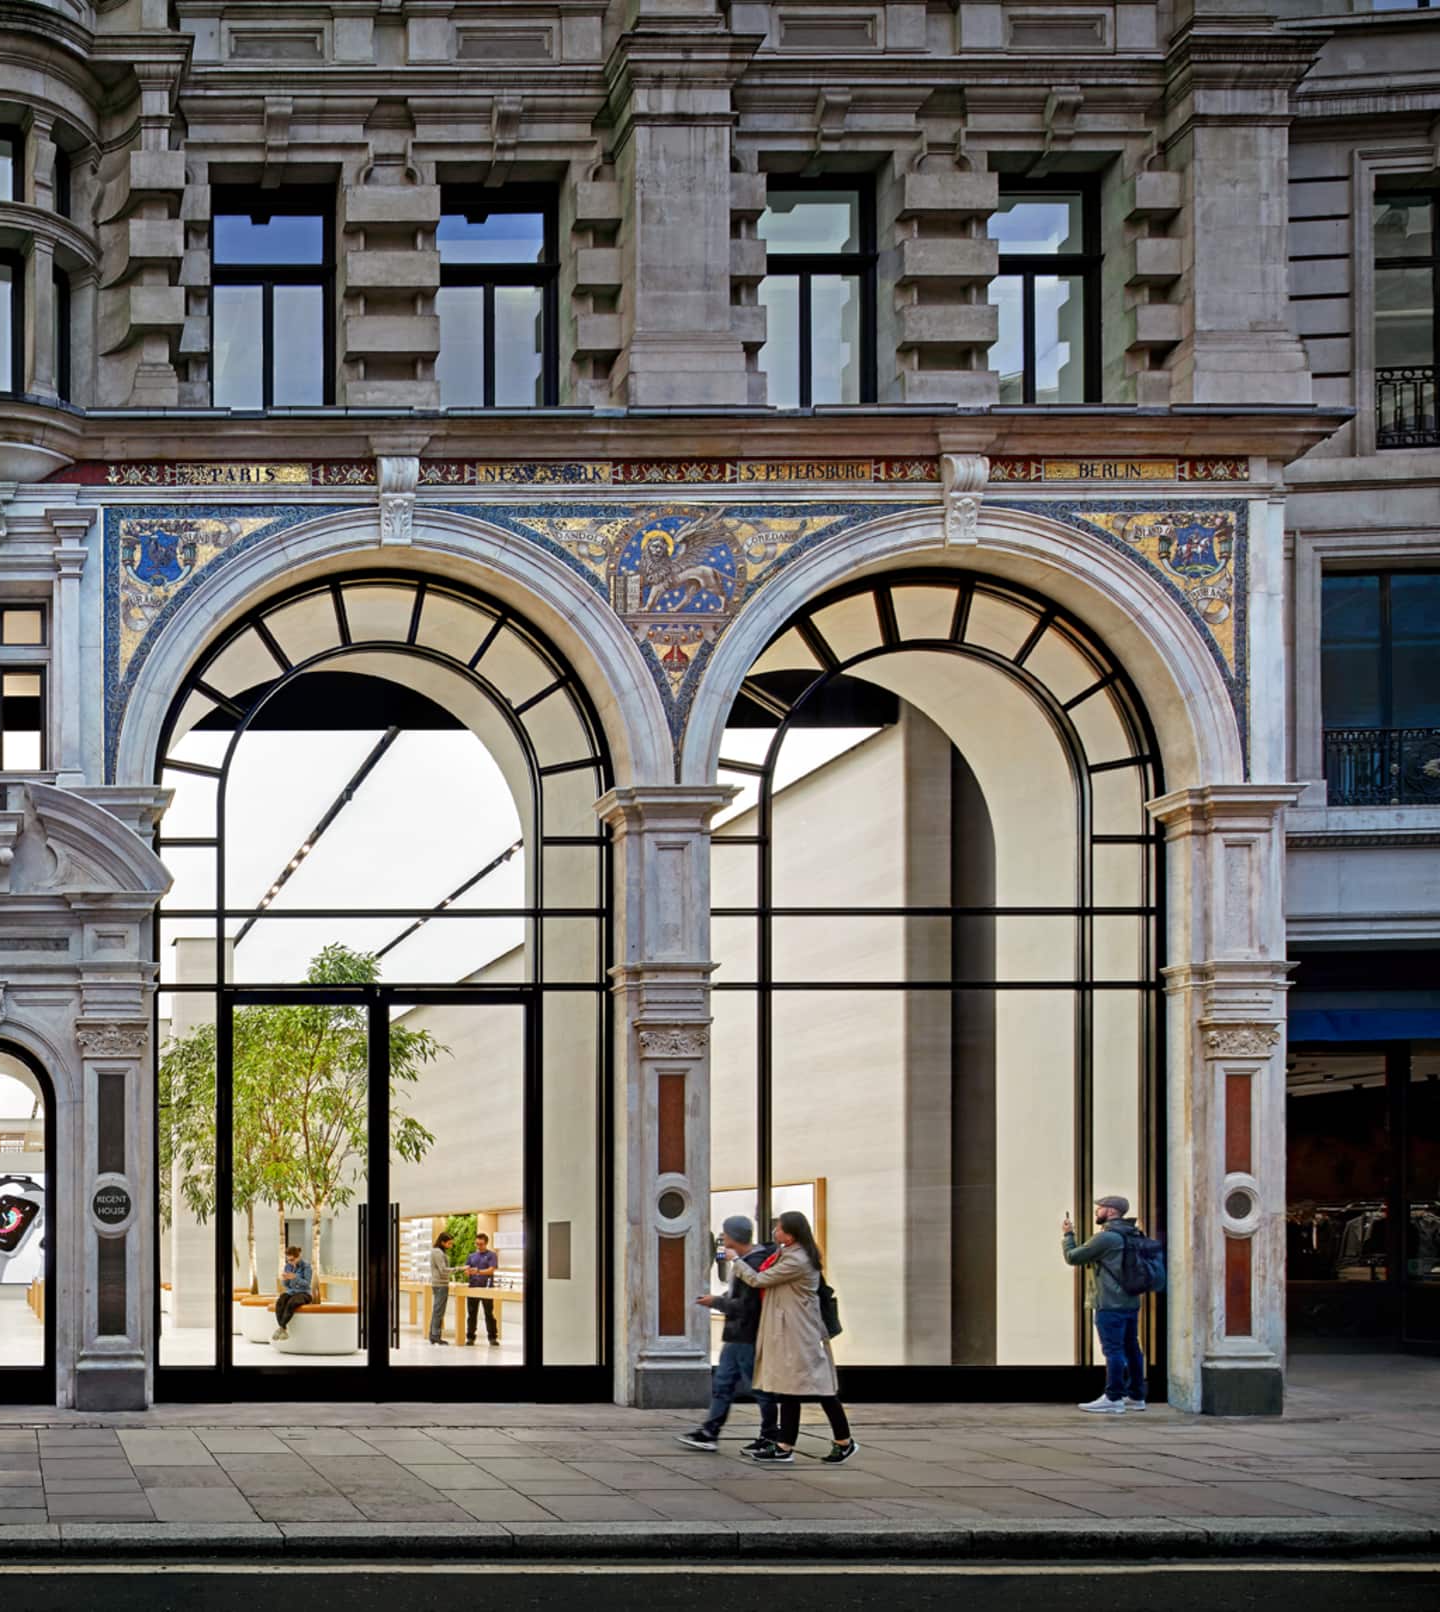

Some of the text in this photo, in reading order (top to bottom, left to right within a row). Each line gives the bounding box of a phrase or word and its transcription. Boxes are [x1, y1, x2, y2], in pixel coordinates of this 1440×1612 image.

[210, 467, 277, 482] PARIS
[484, 466, 536, 481] NEW
[765, 462, 865, 480] PETERSBURG
[1078, 462, 1142, 479] BERLIN
[97, 1207, 126, 1216] HOUSE
